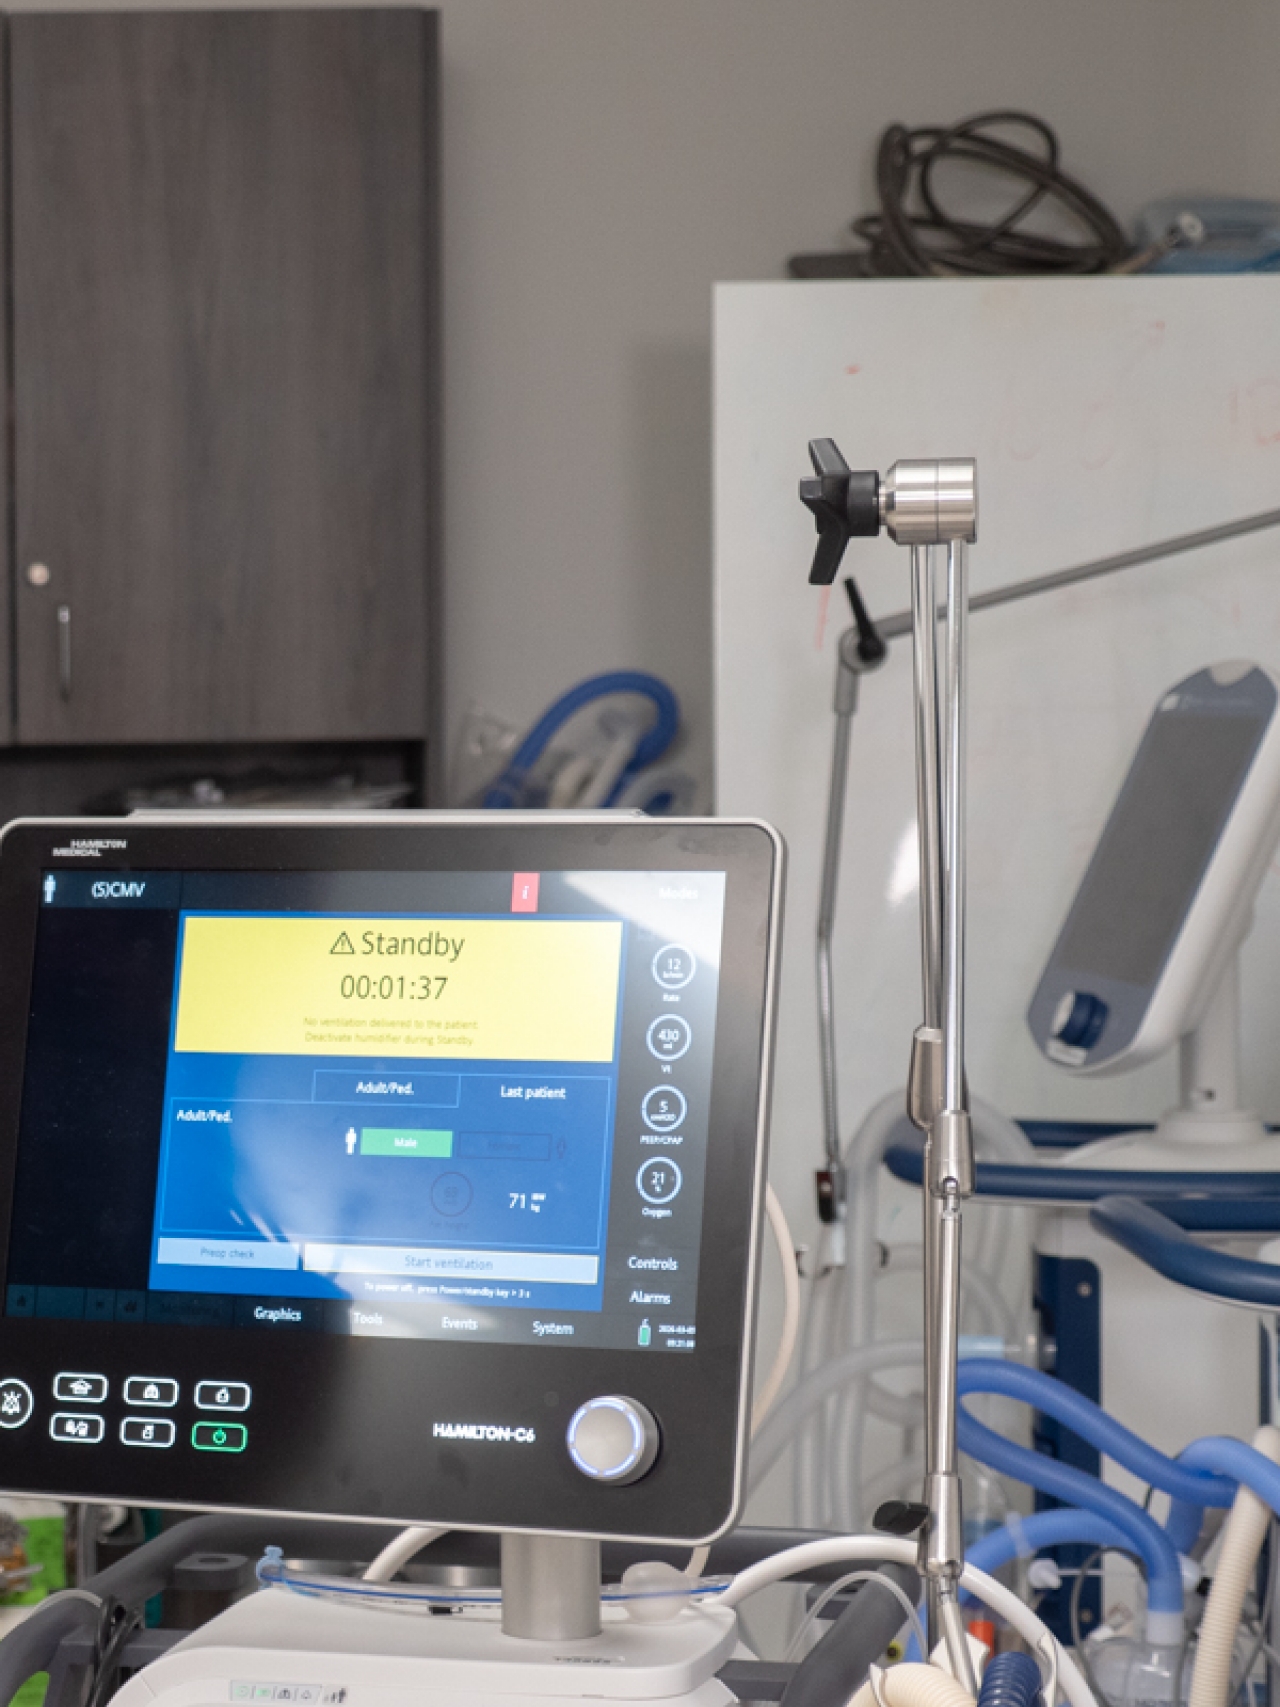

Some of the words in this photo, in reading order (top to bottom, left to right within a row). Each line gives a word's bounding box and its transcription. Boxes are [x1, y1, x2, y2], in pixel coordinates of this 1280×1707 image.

[52, 847, 102, 857] MEDICAL
[70, 839, 128, 850] HAMILTON
[91, 882, 146, 899] (S)CMV
[361, 930, 466, 963] Standby
[667, 957, 682, 971] 12
[340, 974, 449, 1000] 00:01:37
[303, 1017, 319, 1028] No
[320, 1017, 367, 1028] ventilation
[369, 1018, 413, 1029] delivered
[414, 1019, 425, 1029] to
[427, 1019, 443, 1030] the
[304, 1031, 353, 1044] Deactivate
[354, 1032, 402, 1044] humidifier
[404, 1034, 435, 1047] during
[356, 1081, 415, 1096] Adult/Ped.
[500, 1083, 523, 1098] Last
[525, 1084, 566, 1102] patient
[176, 1109, 234, 1124] Adult/Ped.
[394, 1137, 419, 1149] Male
[509, 1192, 526, 1209] 71
[200, 1246, 226, 1260] Preop
[229, 1248, 255, 1260] check
[404, 1255, 432, 1269] Start
[434, 1256, 494, 1271] ventilation
[627, 1255, 679, 1270] Controls
[628, 1289, 672, 1304] Alarms
[253, 1306, 302, 1323] Graphics
[353, 1312, 384, 1326] Tools
[441, 1316, 479, 1331] Events
[532, 1319, 575, 1336] System
[432, 1423, 537, 1444] HAMILTON-C6
